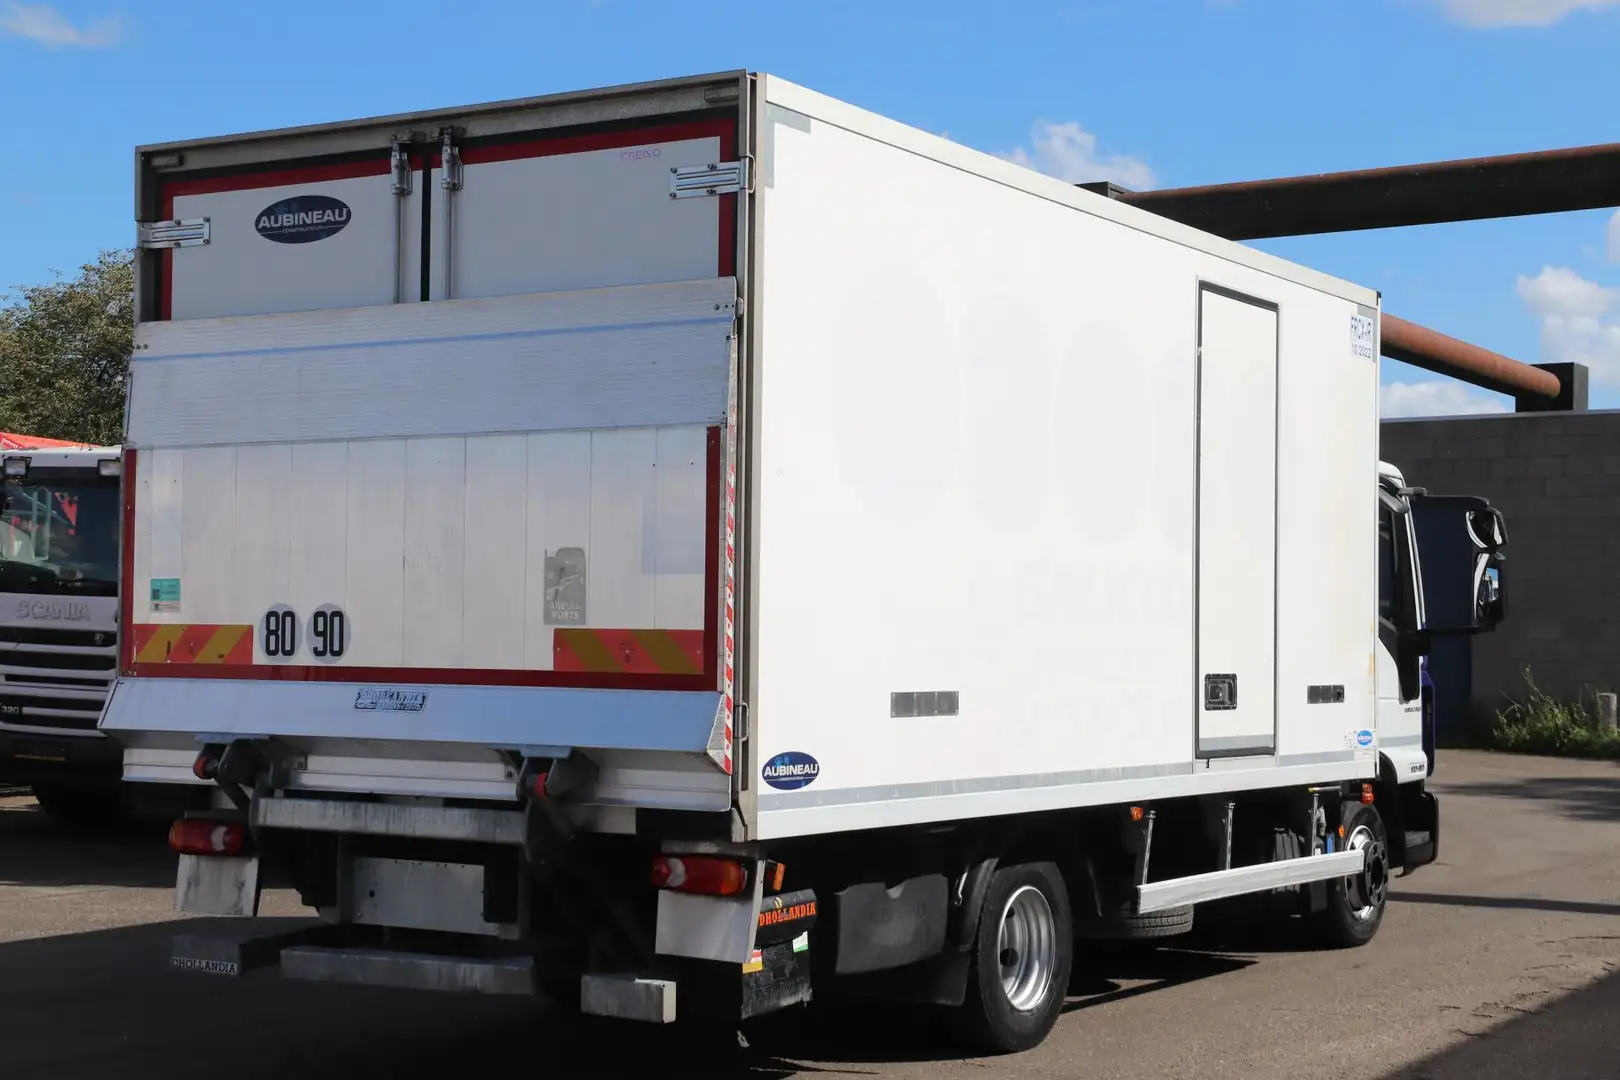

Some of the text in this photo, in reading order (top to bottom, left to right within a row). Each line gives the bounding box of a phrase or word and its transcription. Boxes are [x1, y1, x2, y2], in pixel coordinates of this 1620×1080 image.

[257, 207, 348, 229] AUBINEAU
[16, 601, 91, 621] SCANIA
[265, 610, 345, 657] 80 90
[763, 763, 818, 777] AUBINEAU
[759, 902, 817, 926] DHOLLANDIA
[171, 957, 238, 974] DHOLLANDIA
